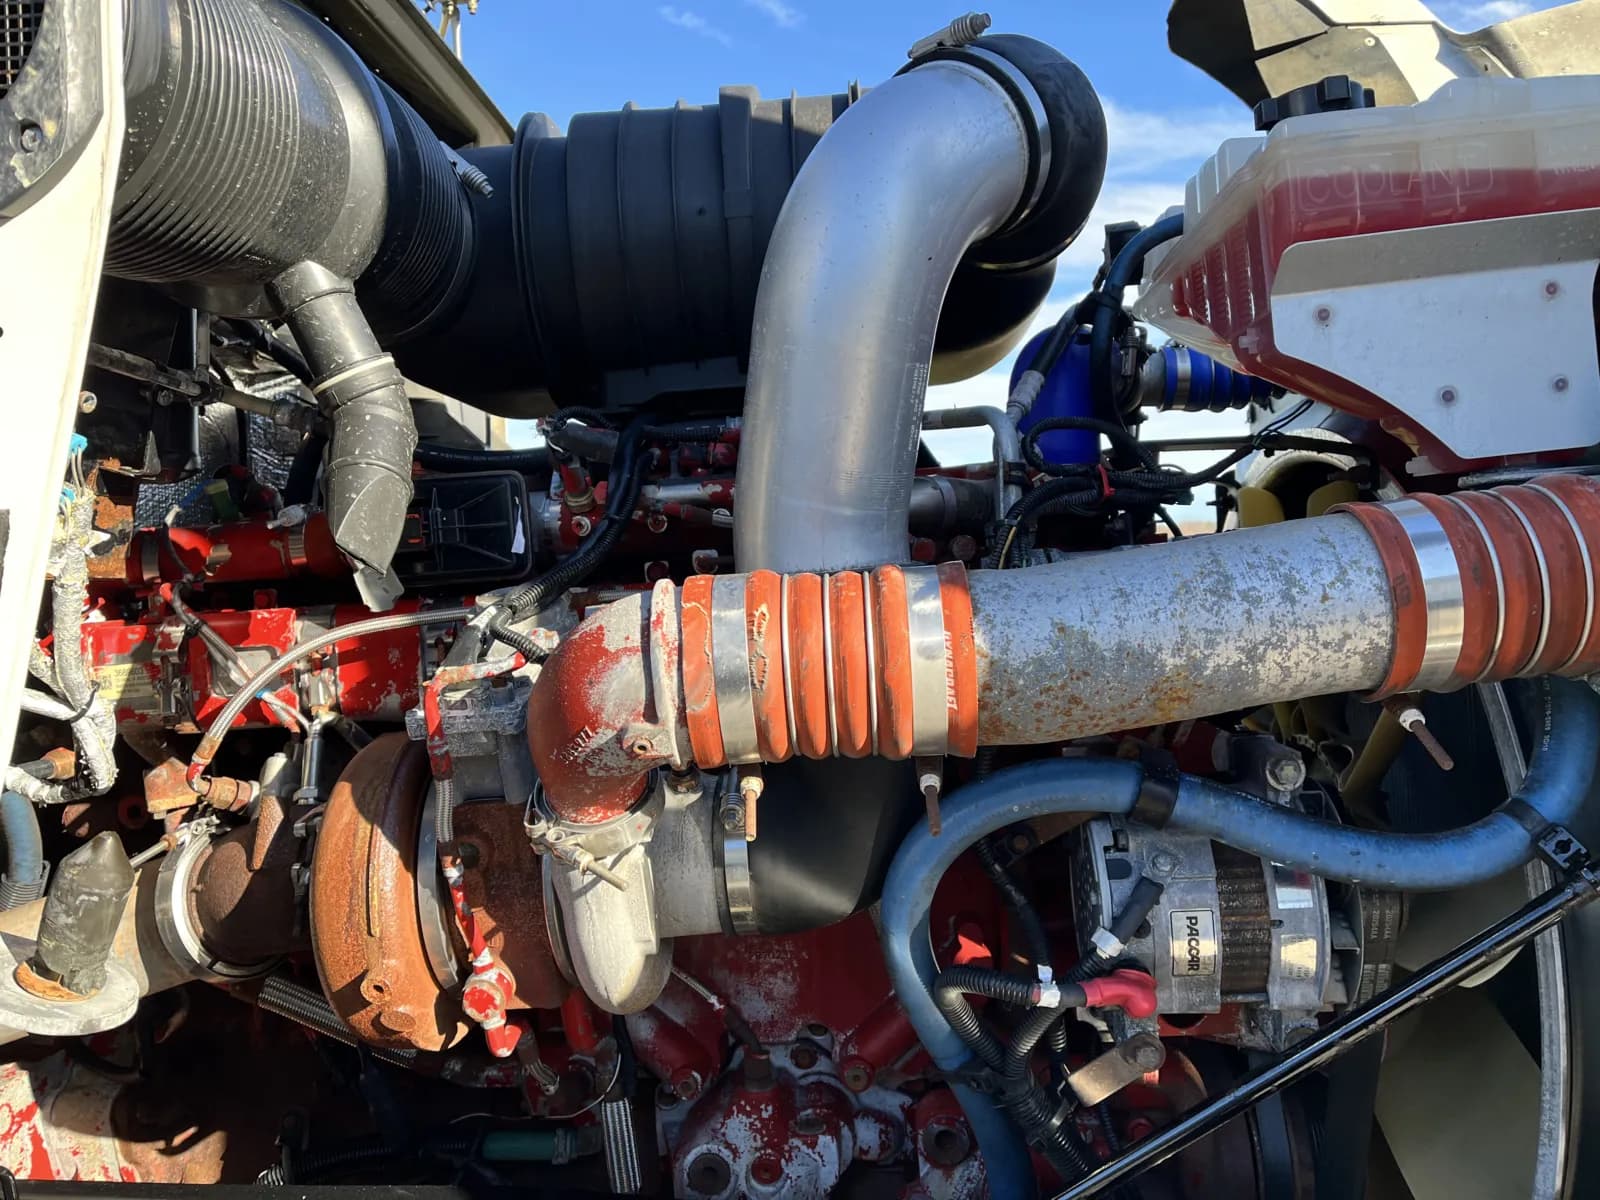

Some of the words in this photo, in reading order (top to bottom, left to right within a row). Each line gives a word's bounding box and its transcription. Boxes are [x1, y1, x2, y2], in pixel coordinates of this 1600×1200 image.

[1306, 154, 1477, 204] COOLANT
[943, 630, 959, 711] DYNACRAFT
[1186, 916, 1200, 972] PACCAR
